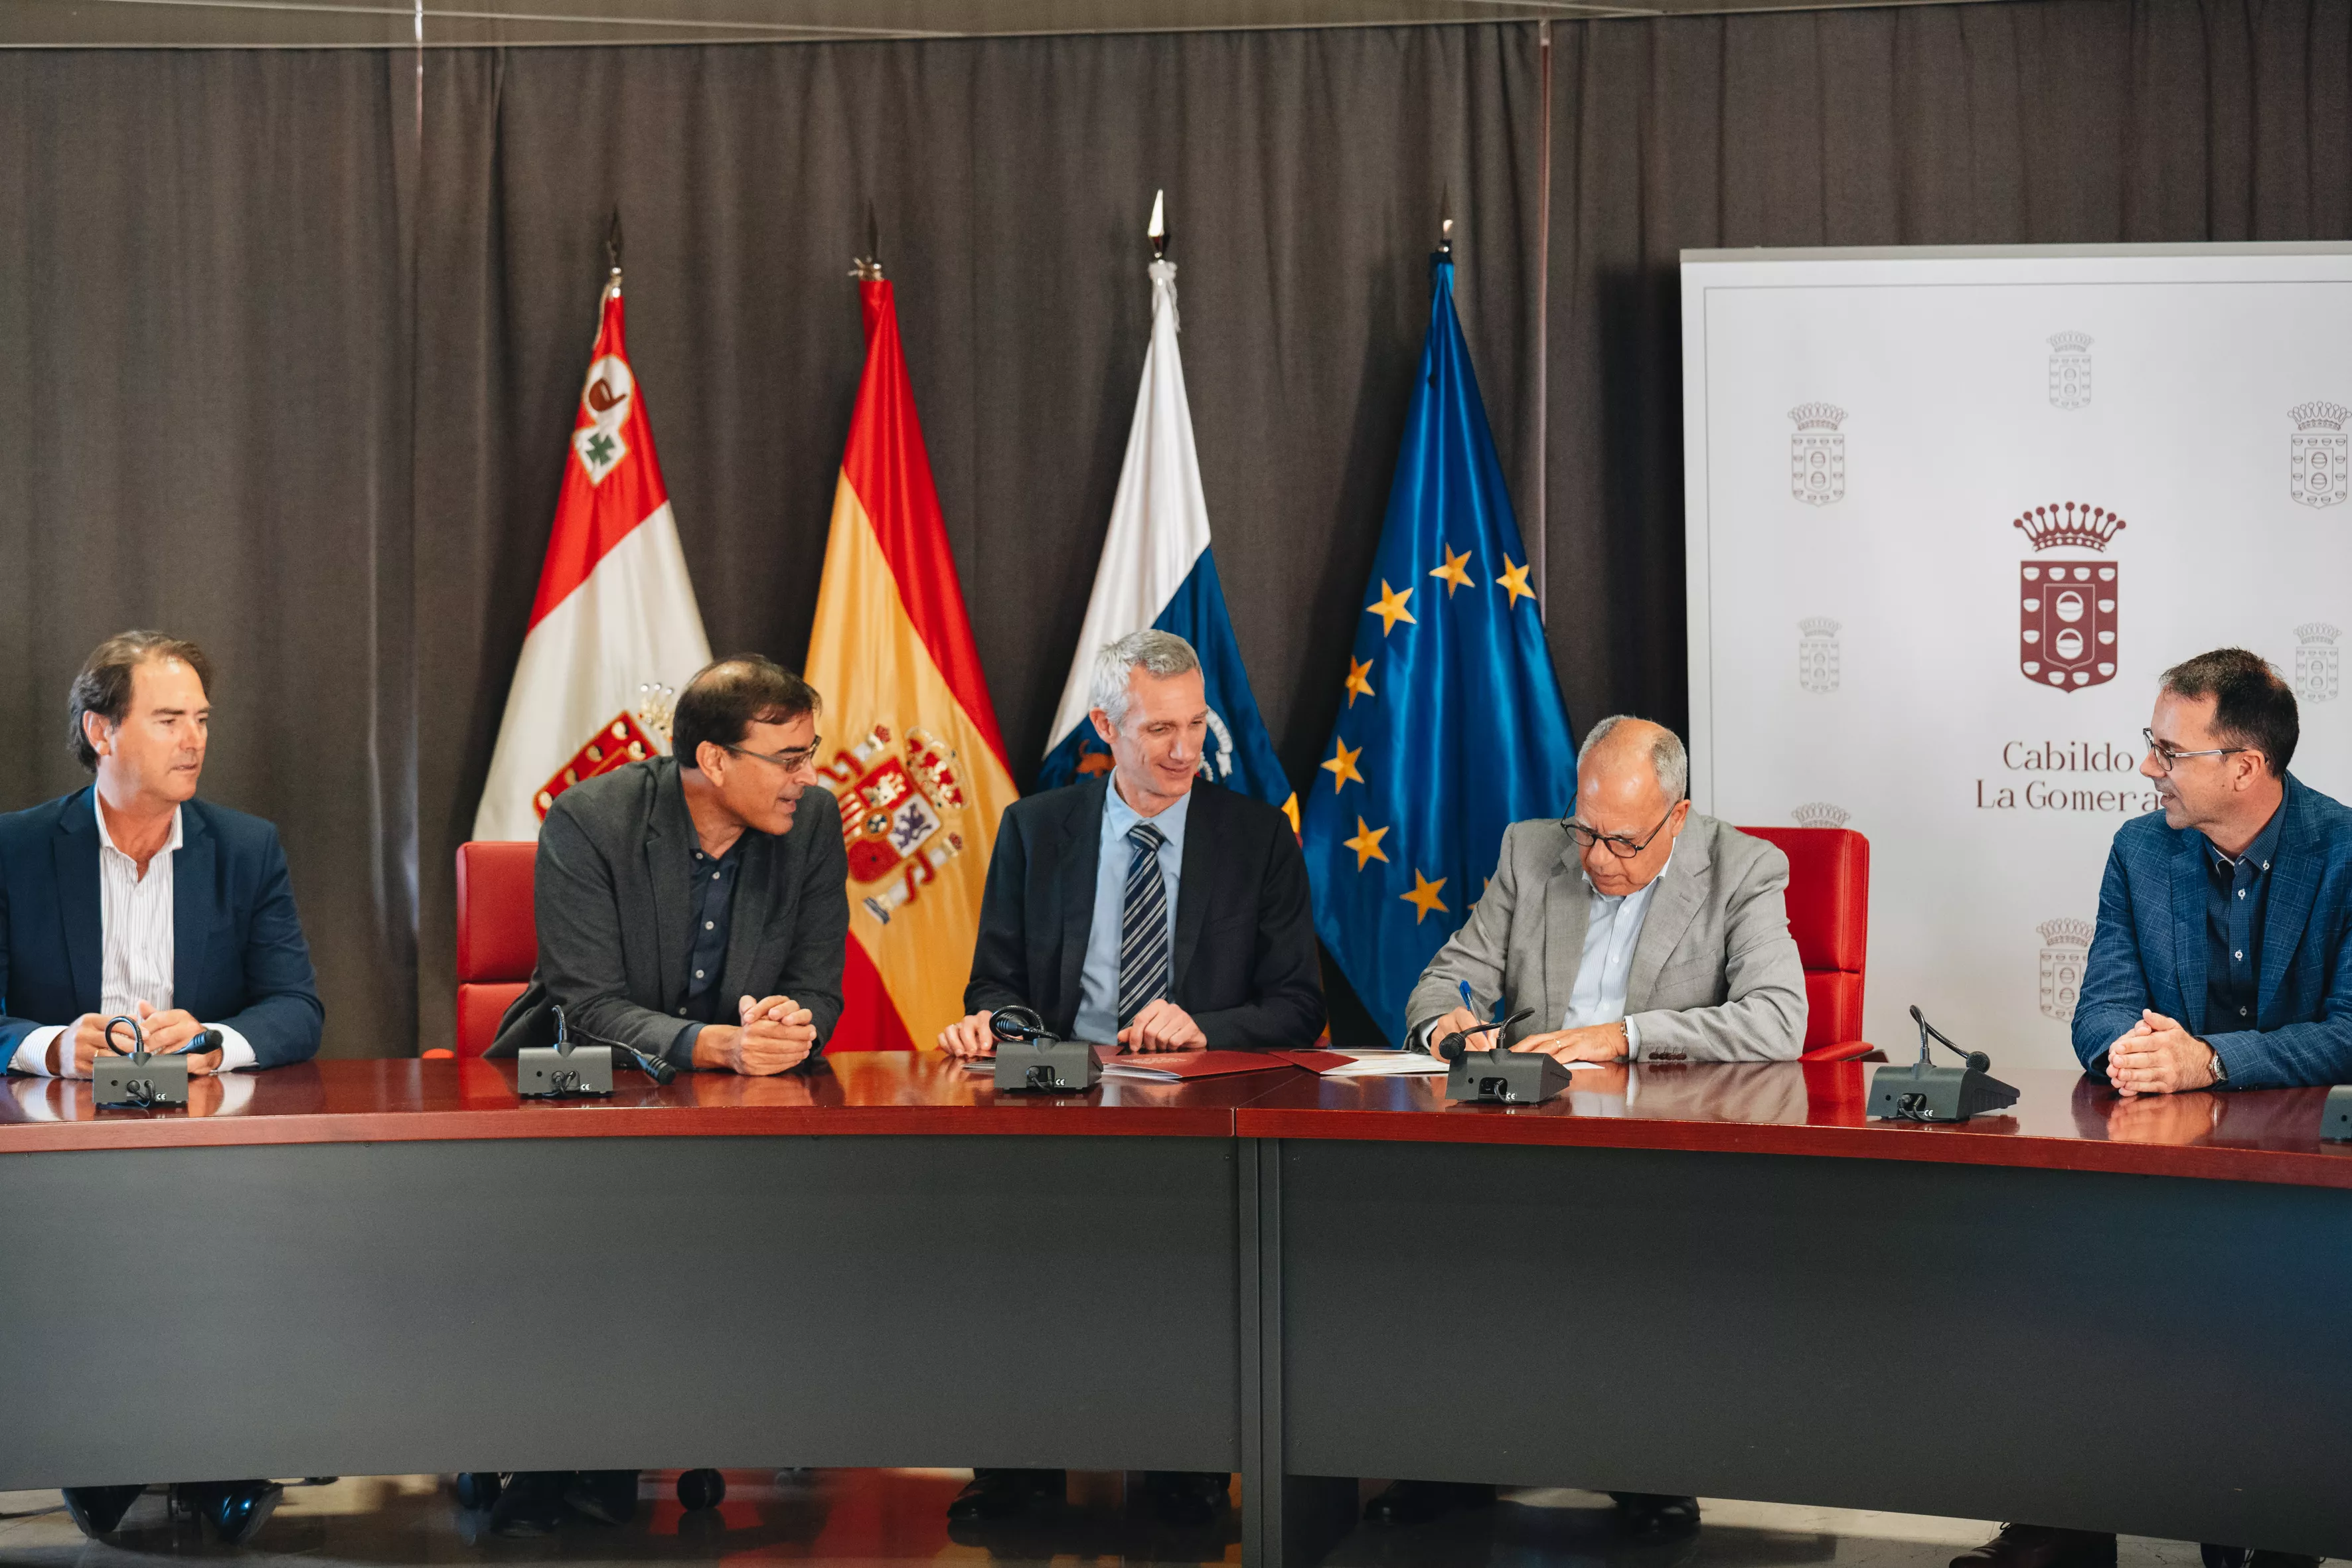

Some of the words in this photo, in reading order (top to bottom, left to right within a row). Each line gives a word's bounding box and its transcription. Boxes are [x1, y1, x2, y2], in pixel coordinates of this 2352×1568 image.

[2003, 740, 2134, 772] Cabildo
[1976, 779, 2016, 809] La
[2026, 780, 2159, 811] Gomera
